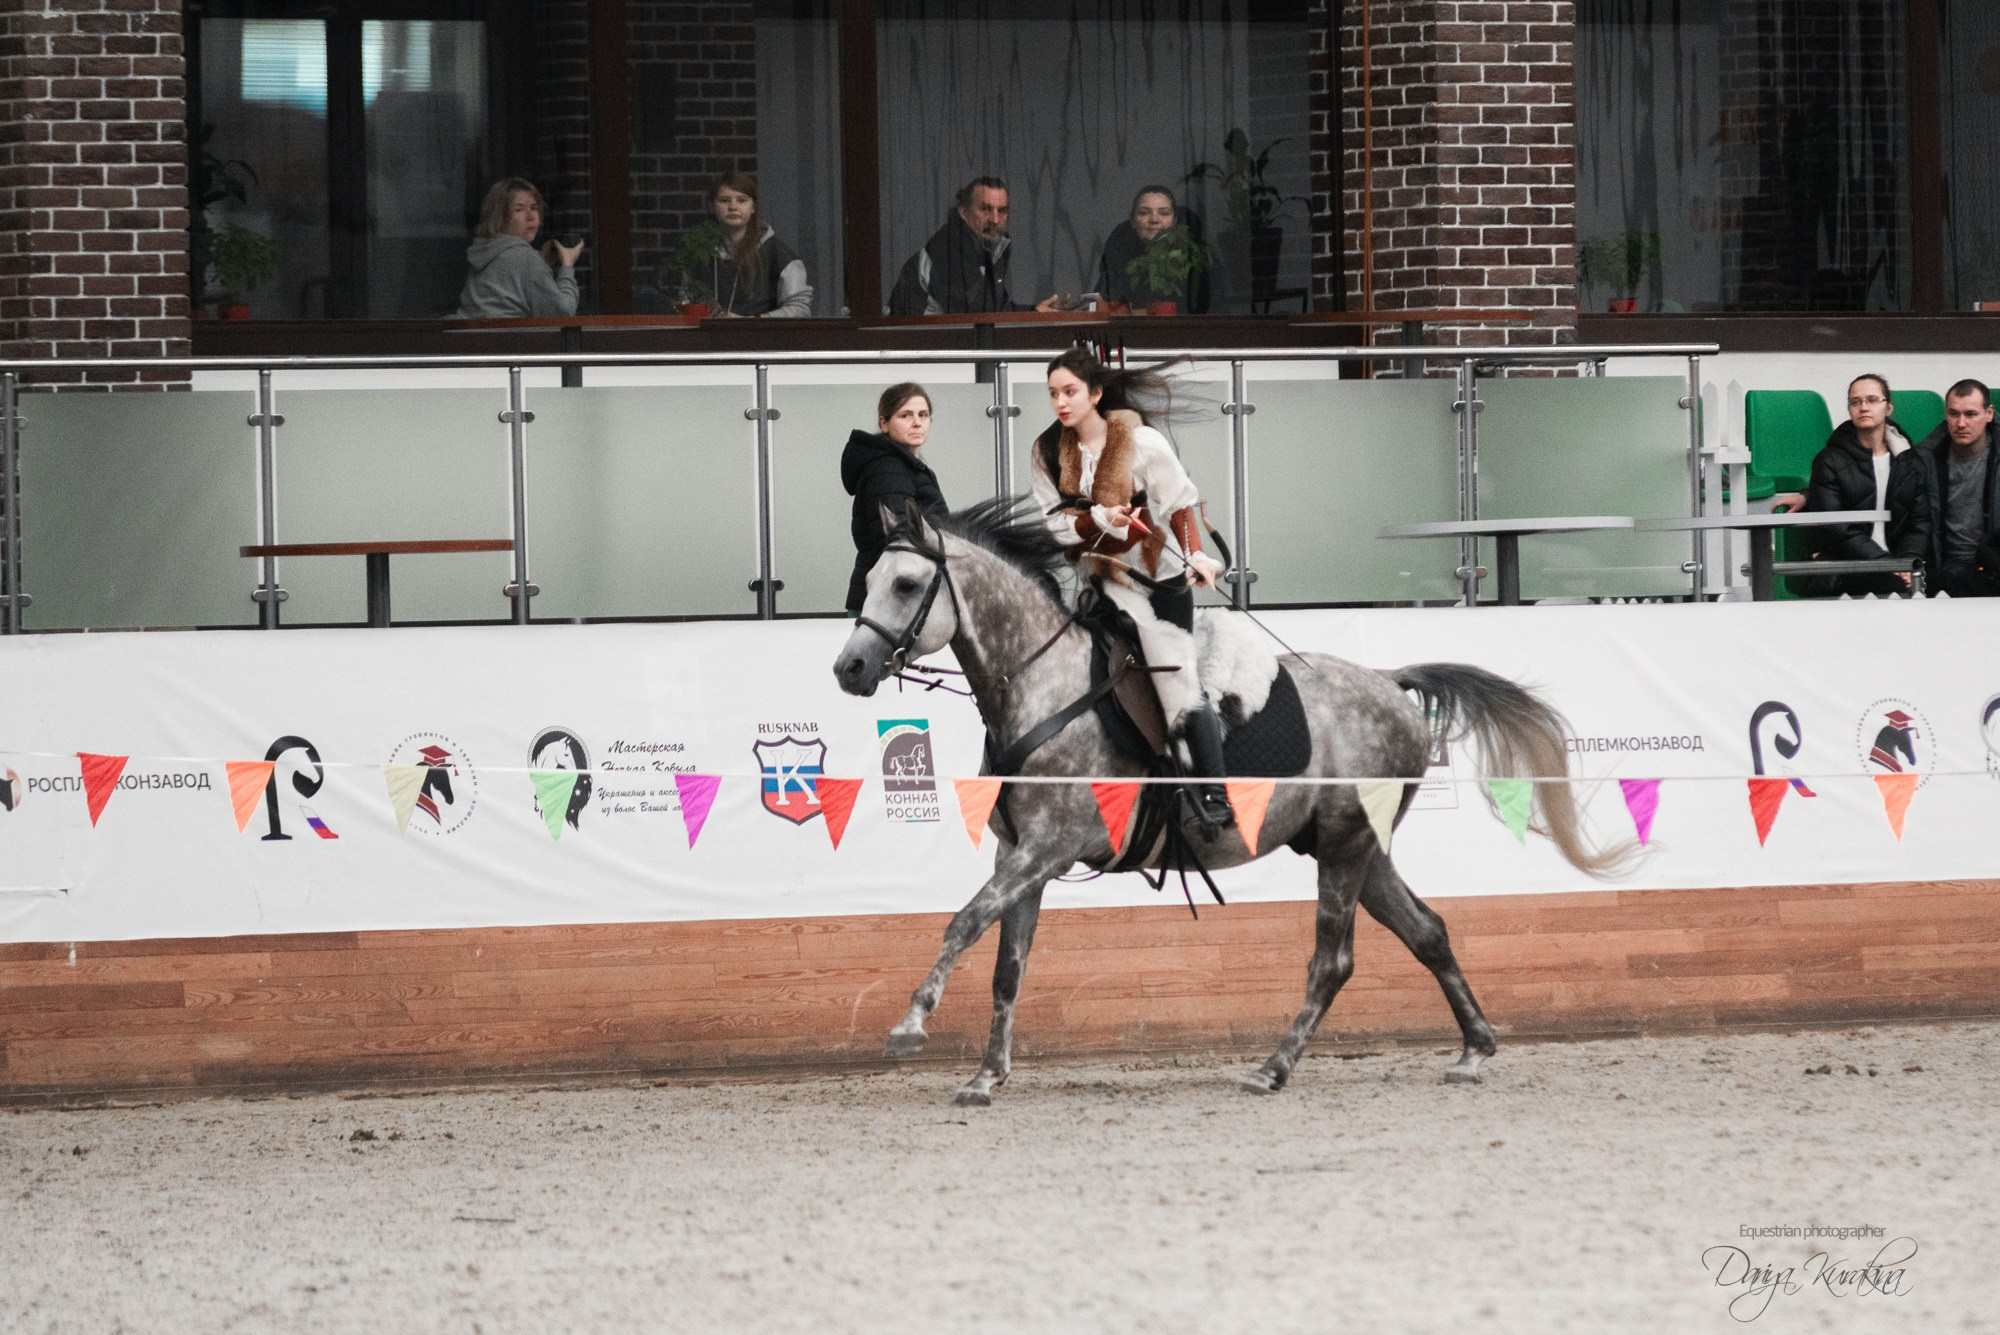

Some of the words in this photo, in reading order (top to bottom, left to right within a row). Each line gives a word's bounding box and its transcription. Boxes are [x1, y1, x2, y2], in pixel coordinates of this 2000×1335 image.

[757, 722, 819, 734] RUSKNAB
[608, 739, 685, 756] Мастерская
[1565, 735, 1705, 753] СПЛЕМКОНЗАВОД
[28, 773, 212, 793] РОСПЛКОНЗАВОД
[885, 792, 938, 805] КОННАЯ
[886, 806, 940, 819] РОССИЯ
